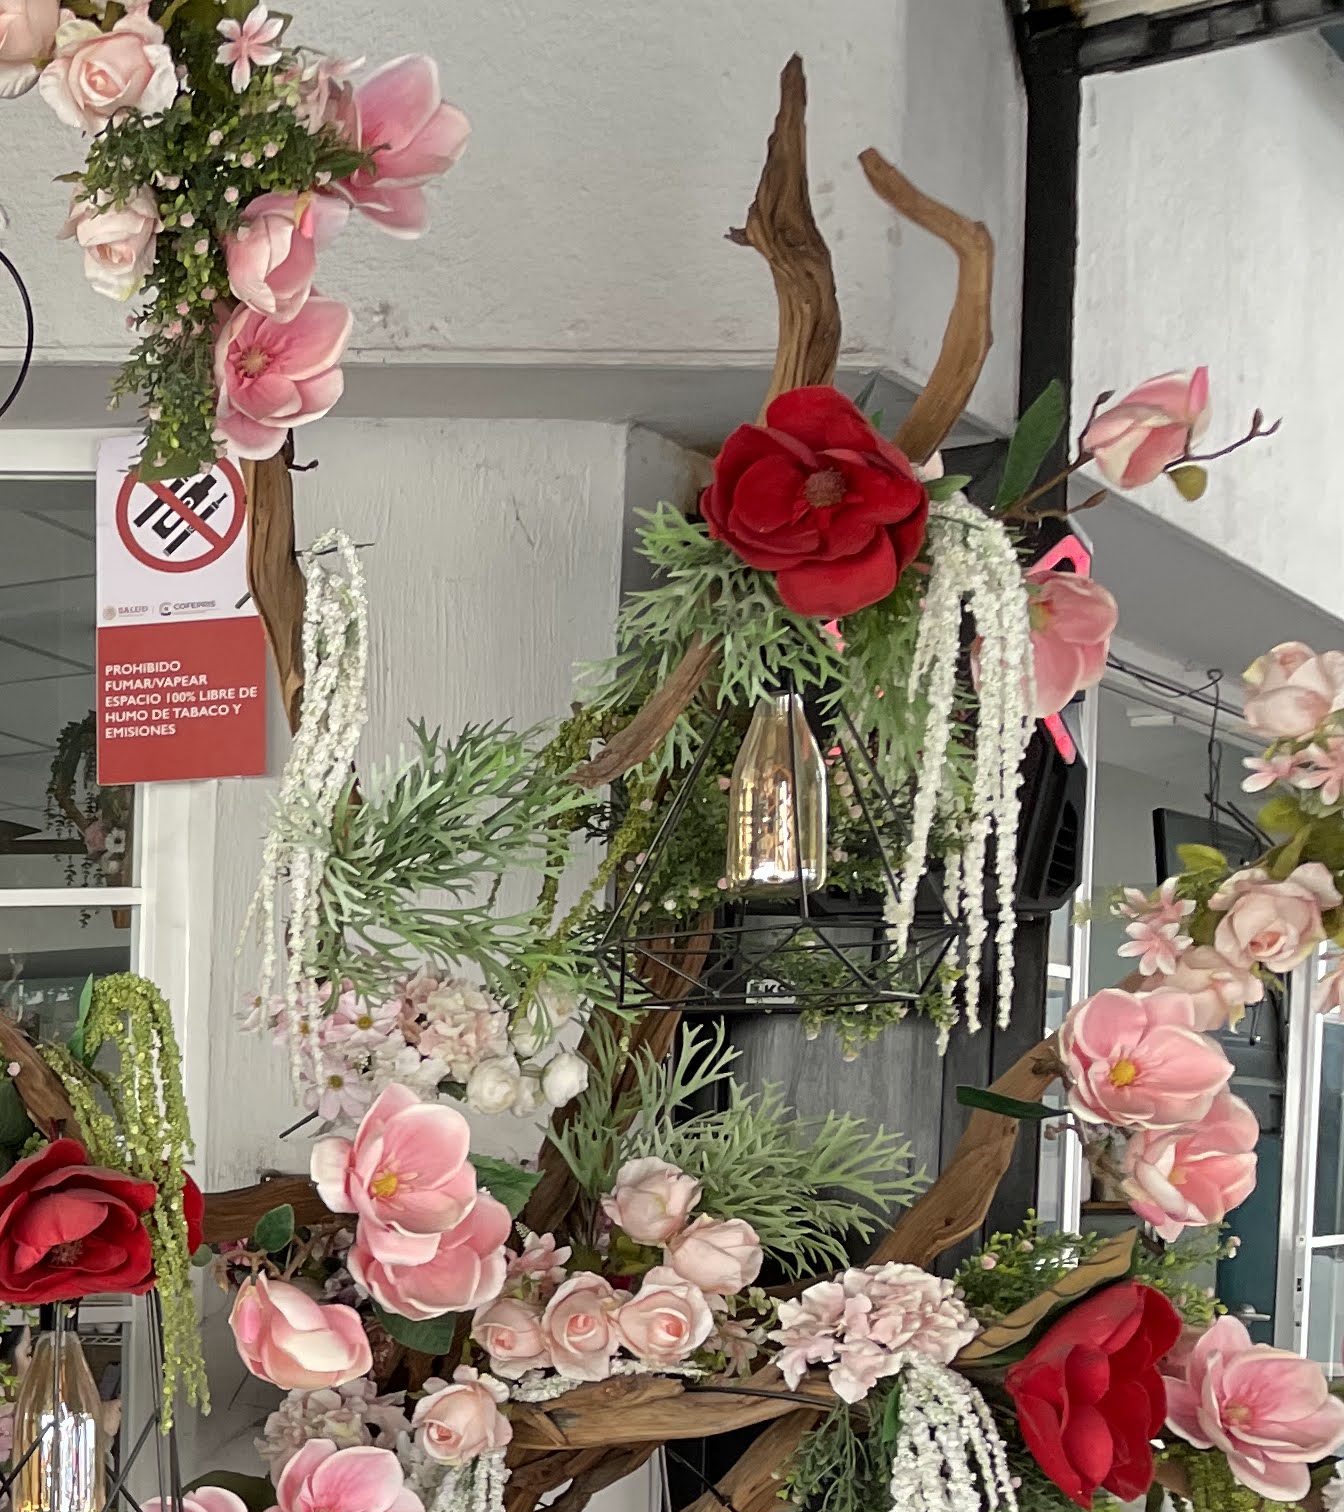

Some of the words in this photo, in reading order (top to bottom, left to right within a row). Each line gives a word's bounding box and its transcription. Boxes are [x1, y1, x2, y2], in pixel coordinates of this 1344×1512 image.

[105, 660, 181, 676] PROHIBIDO
[105, 674, 208, 691] FUMAR/VAPEAR
[105, 693, 161, 707] ESPACIO
[166, 691, 196, 703] 100%
[199, 688, 235, 701] LIBRE
[239, 686, 258, 699] DE
[105, 710, 148, 723] HUMO
[151, 708, 170, 720] DE
[173, 704, 229, 719] TABACO
[232, 703, 242, 715] Y
[105, 724, 176, 738] EMISIONES
